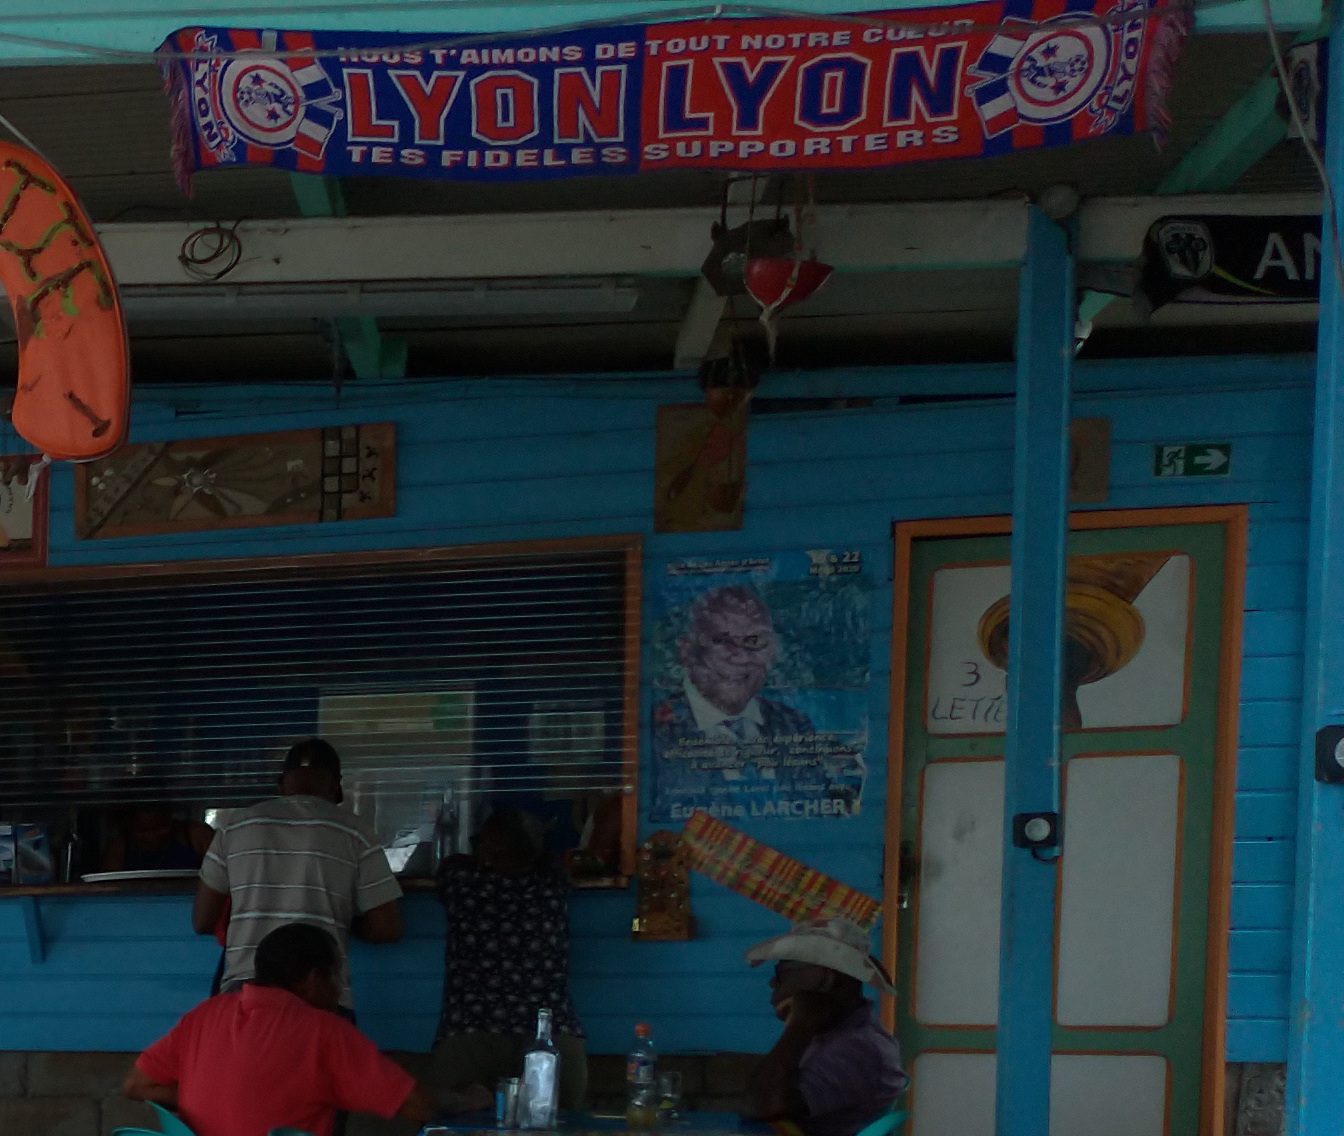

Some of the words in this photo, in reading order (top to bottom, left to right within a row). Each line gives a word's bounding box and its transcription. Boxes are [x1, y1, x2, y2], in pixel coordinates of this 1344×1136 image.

[338, 46, 422, 63] NOUS
[429, 44, 583, 64] T'AIMONS
[595, 41, 637, 60] DE
[645, 34, 730, 56] TOUT
[741, 30, 852, 50] NOTRE
[342, 64, 628, 145] LYON
[658, 41, 968, 139] LYON
[346, 145, 426, 165] TES
[441, 146, 628, 167] FIDELES
[643, 126, 959, 161] SUPPORTERS
[962, 661, 981, 687] 3
[749, 797, 850, 817] LARCHER
